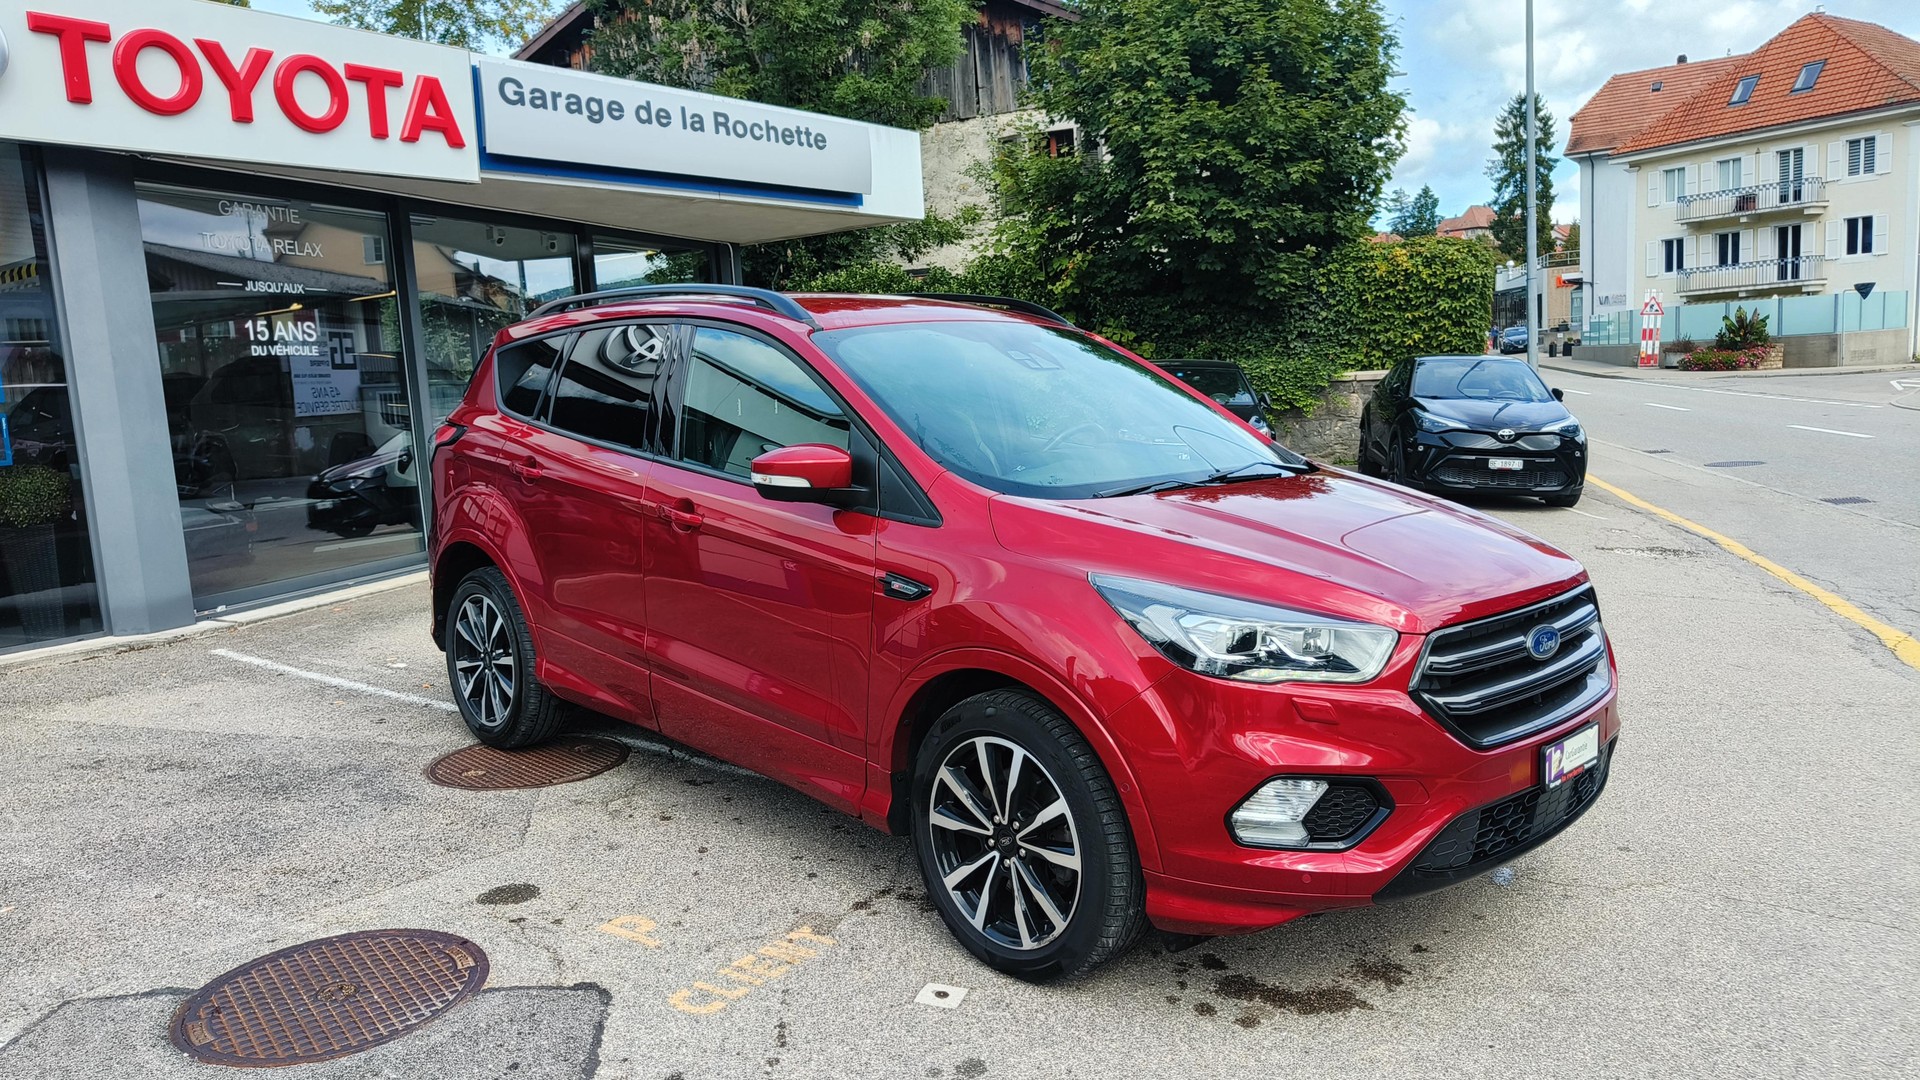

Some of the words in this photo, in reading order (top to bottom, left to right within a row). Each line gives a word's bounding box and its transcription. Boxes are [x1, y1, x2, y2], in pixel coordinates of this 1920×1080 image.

[26, 11, 466, 149] TOYOTA
[498, 77, 625, 124] Garage
[635, 101, 672, 128] de
[681, 105, 705, 133] la
[713, 110, 828, 151] Rochette
[218, 200, 300, 224] GARANTIE
[201, 231, 272, 253] TOYOTA
[273, 238, 324, 258] RELAX
[245, 280, 305, 294] JUSQU'AUX
[244, 319, 270, 341] 15
[274, 321, 317, 342] ANS
[251, 345, 267, 356] DU
[268, 343, 320, 356] VÉHICULE
[1539, 633, 1556, 652] Ford
[599, 914, 663, 949] P
[668, 926, 838, 1015] CLIENT
